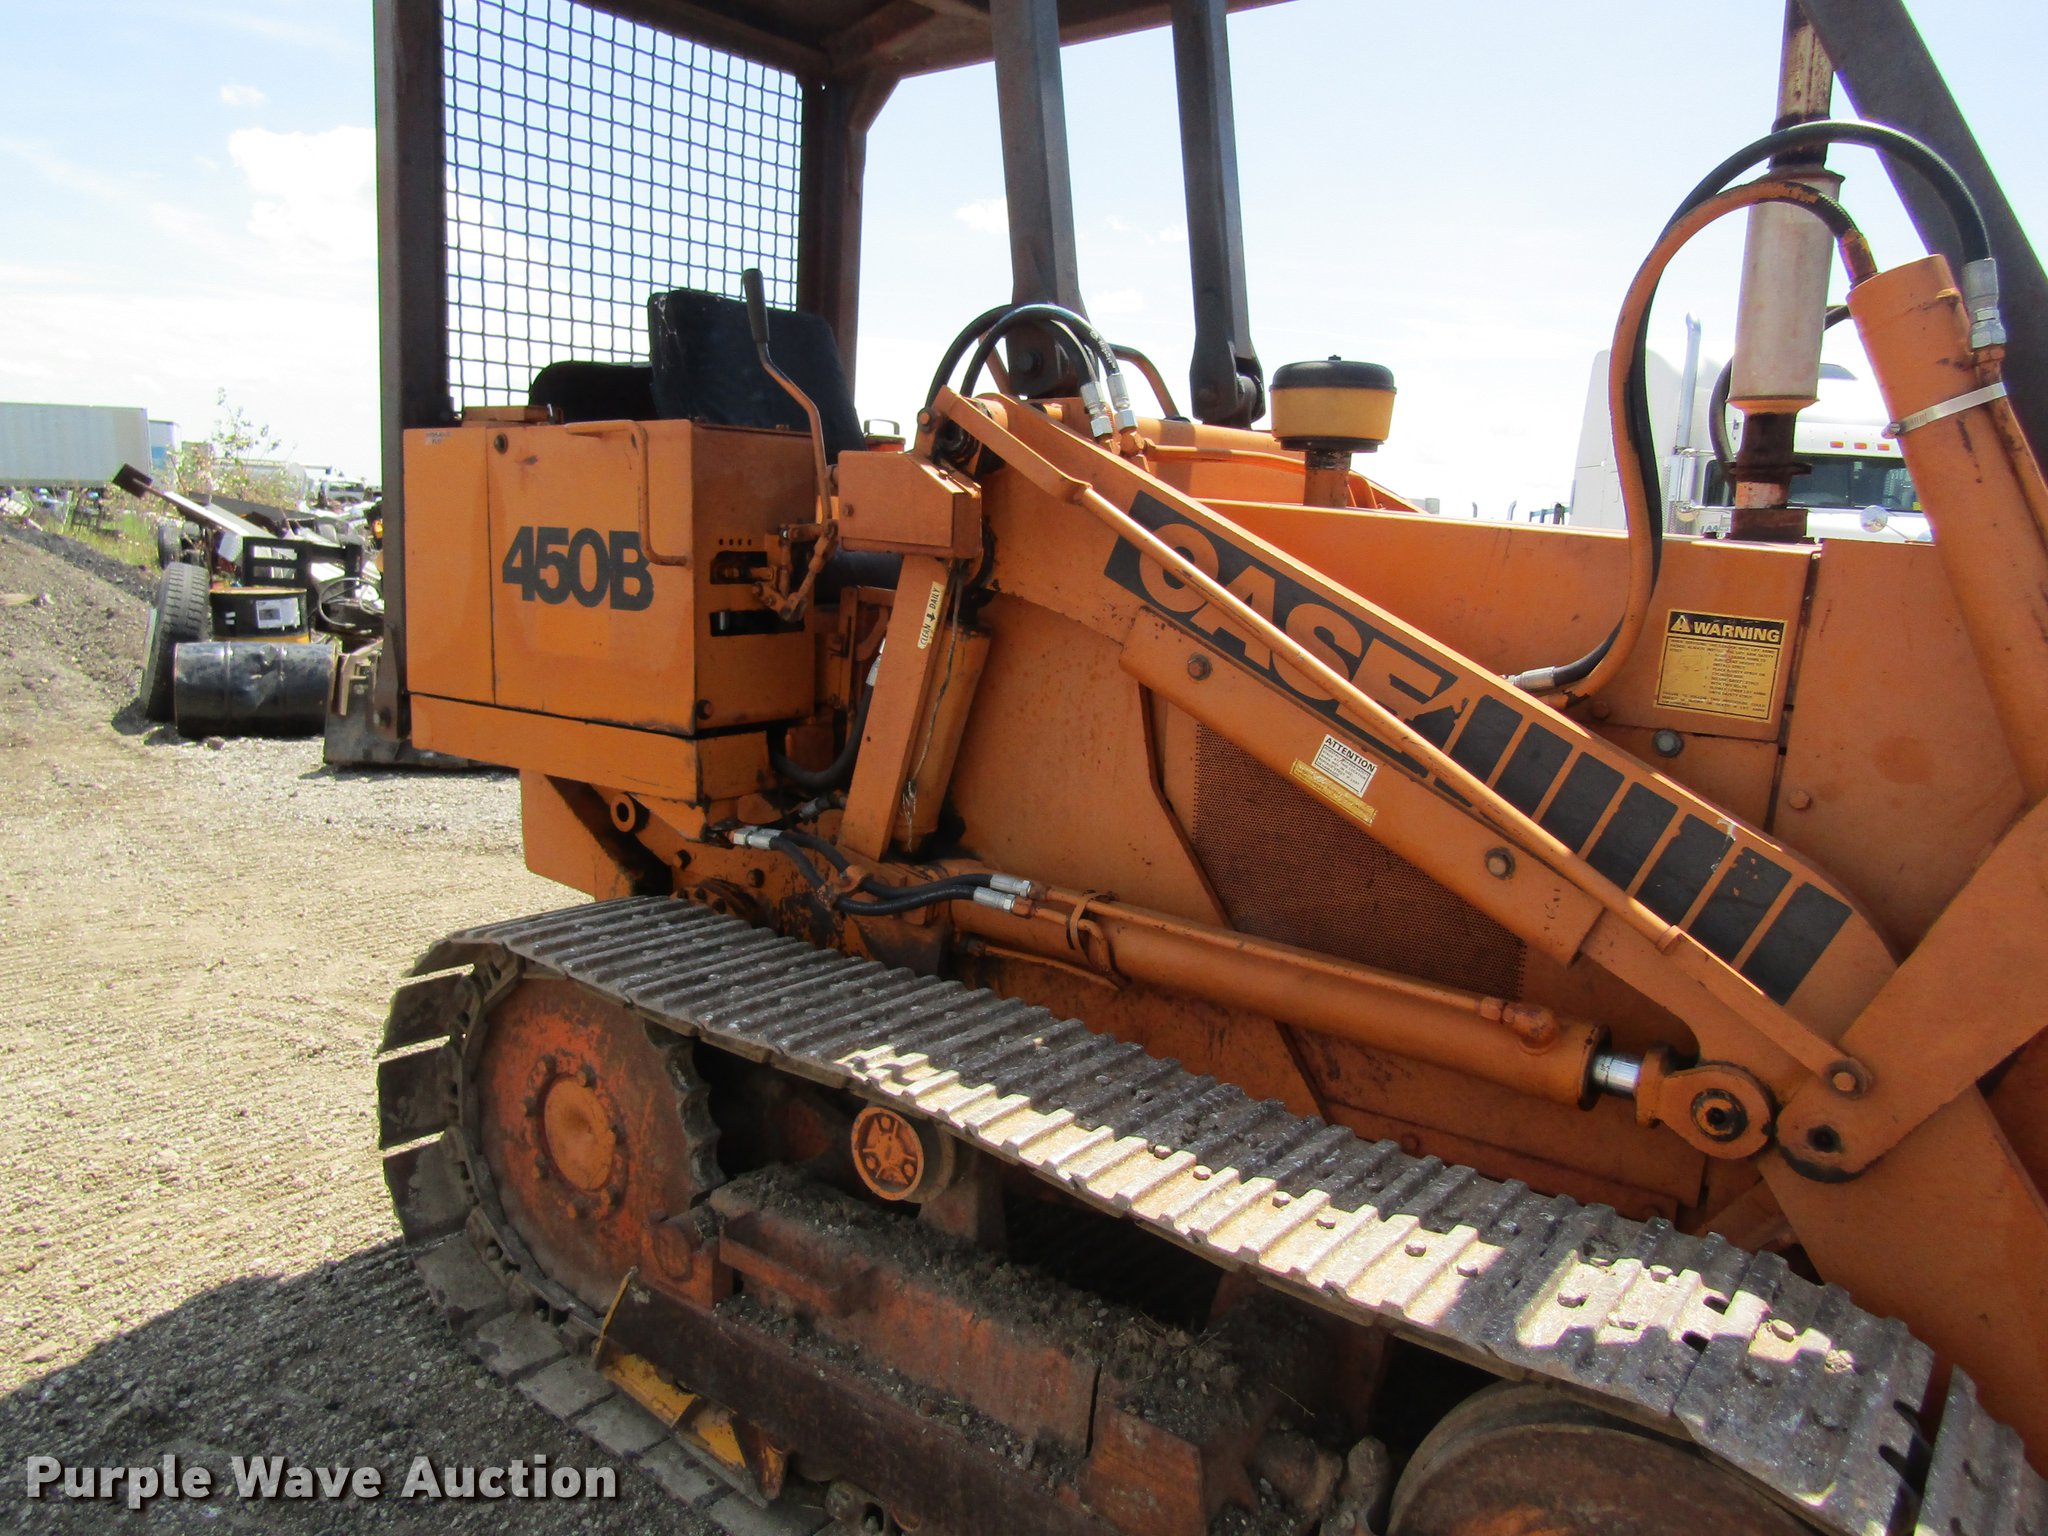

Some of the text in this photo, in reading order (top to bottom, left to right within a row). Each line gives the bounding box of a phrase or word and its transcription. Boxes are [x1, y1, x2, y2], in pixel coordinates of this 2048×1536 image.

[502, 526, 654, 611] 450B
[920, 587, 940, 645] CLEAN DAILY
[1139, 523, 1443, 755] CASE
[1693, 621, 1780, 643] WARNING
[1325, 737, 1376, 773] ATTENTION
